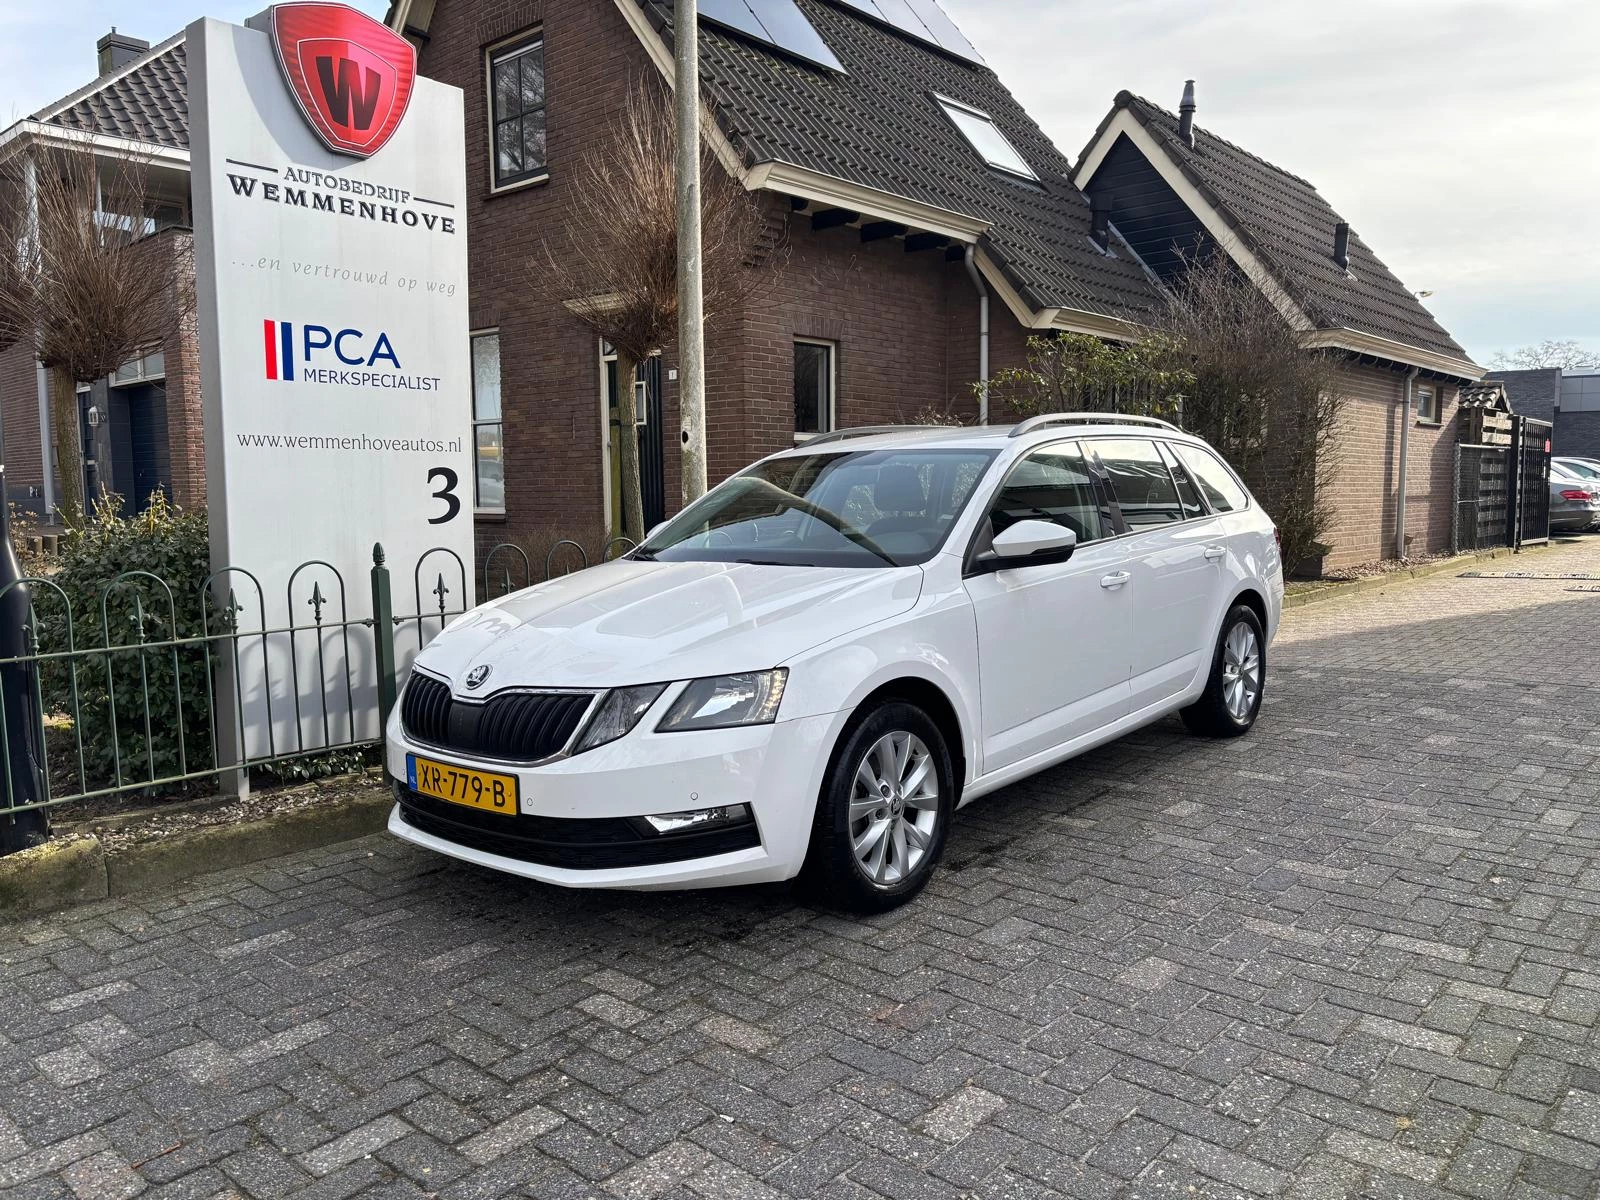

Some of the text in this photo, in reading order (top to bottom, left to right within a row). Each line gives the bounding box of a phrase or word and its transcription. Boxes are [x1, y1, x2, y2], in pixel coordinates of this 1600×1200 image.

[315, 56, 382, 131] W
[226, 173, 456, 235] WEMMENHOVE
[284, 167, 411, 203] AUTOBEDRIJF
[292, 260, 388, 286] vertrouwd
[397, 276, 417, 291] op
[426, 280, 456, 298] weg
[303, 324, 402, 369] PCA
[303, 368, 441, 391] MERKSPECIALIST
[236, 433, 462, 453] www.wemmenhoveautos.nl
[426, 466, 461, 525] 3
[420, 763, 506, 808] XR-779-B
